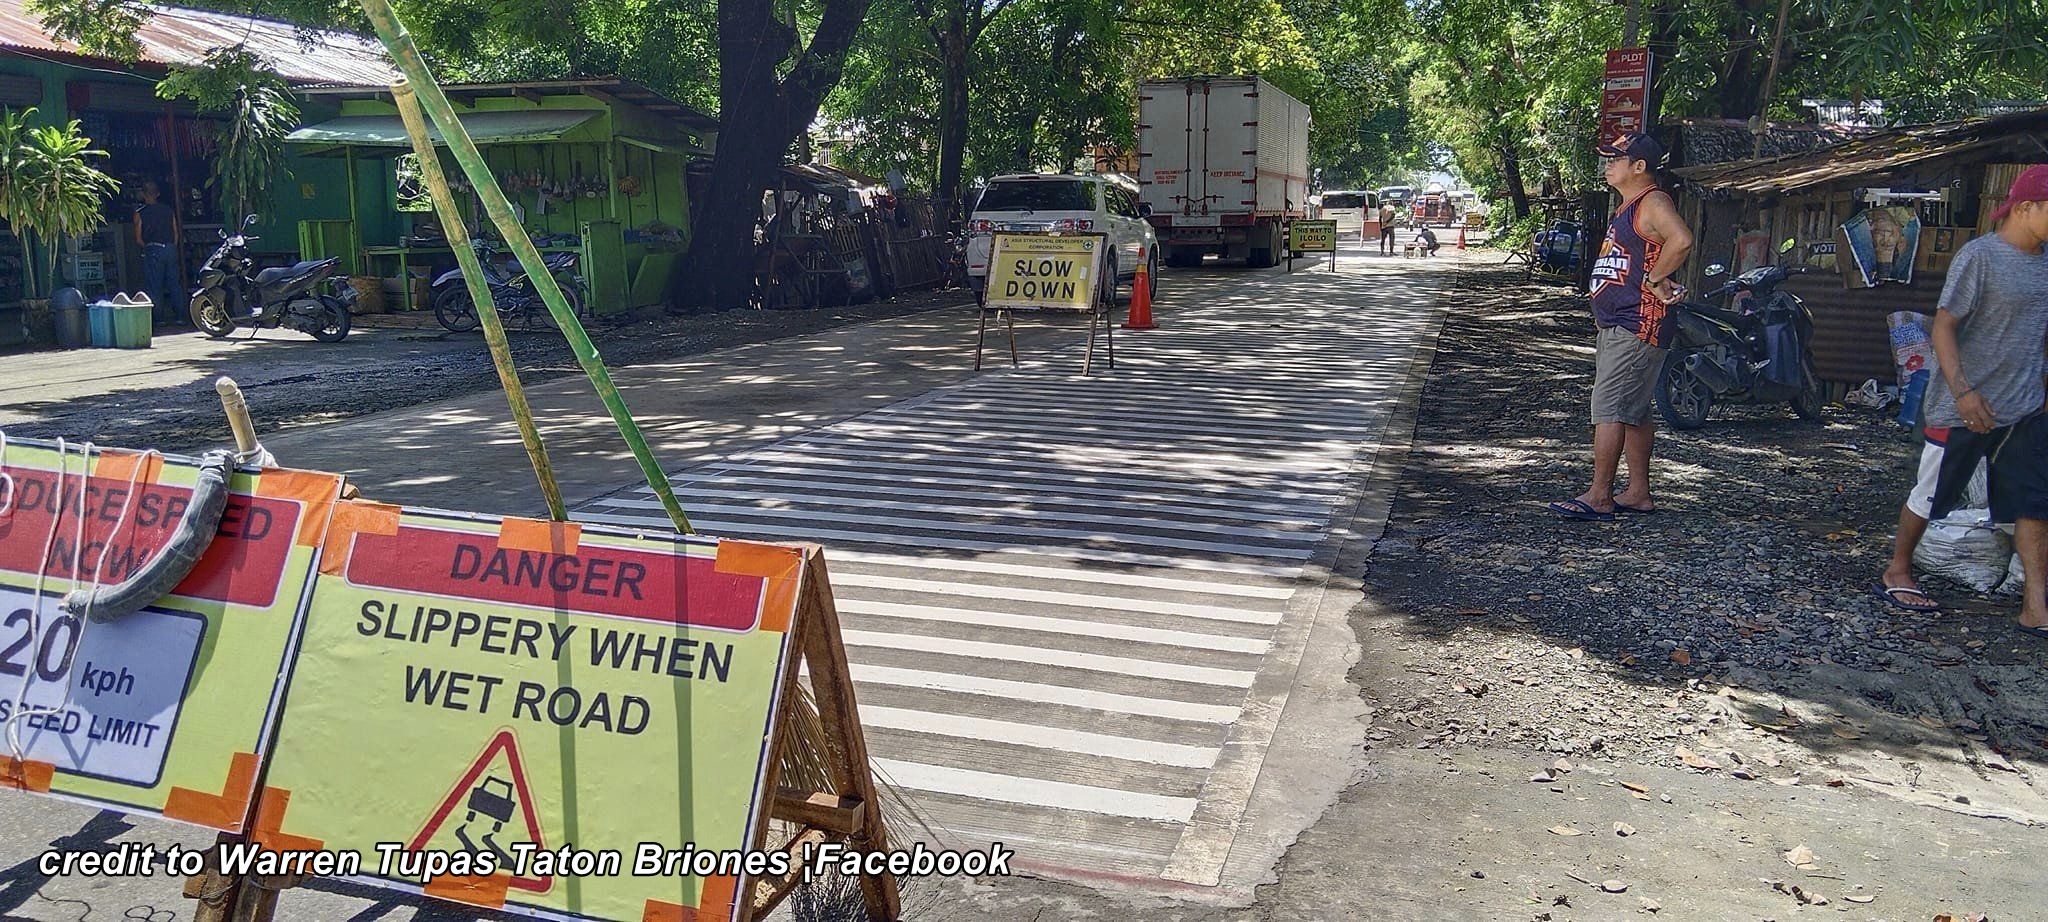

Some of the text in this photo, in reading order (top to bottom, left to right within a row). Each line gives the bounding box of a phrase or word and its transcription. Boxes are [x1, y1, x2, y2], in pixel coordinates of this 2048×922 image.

[1621, 53, 1644, 62] PLDT
[1014, 259, 1073, 277] SLOW
[1006, 281, 1075, 299] DOWN
[0, 476, 273, 541] EDUCE SPED
[49, 536, 151, 579] NOW
[450, 544, 646, 600] DANGER
[0, 608, 81, 683] 20
[356, 600, 734, 682] SLIPPERY WHEN
[80, 661, 135, 696] kph
[405, 665, 650, 735] WET ROAD
[87, 714, 160, 748] LIMIT
